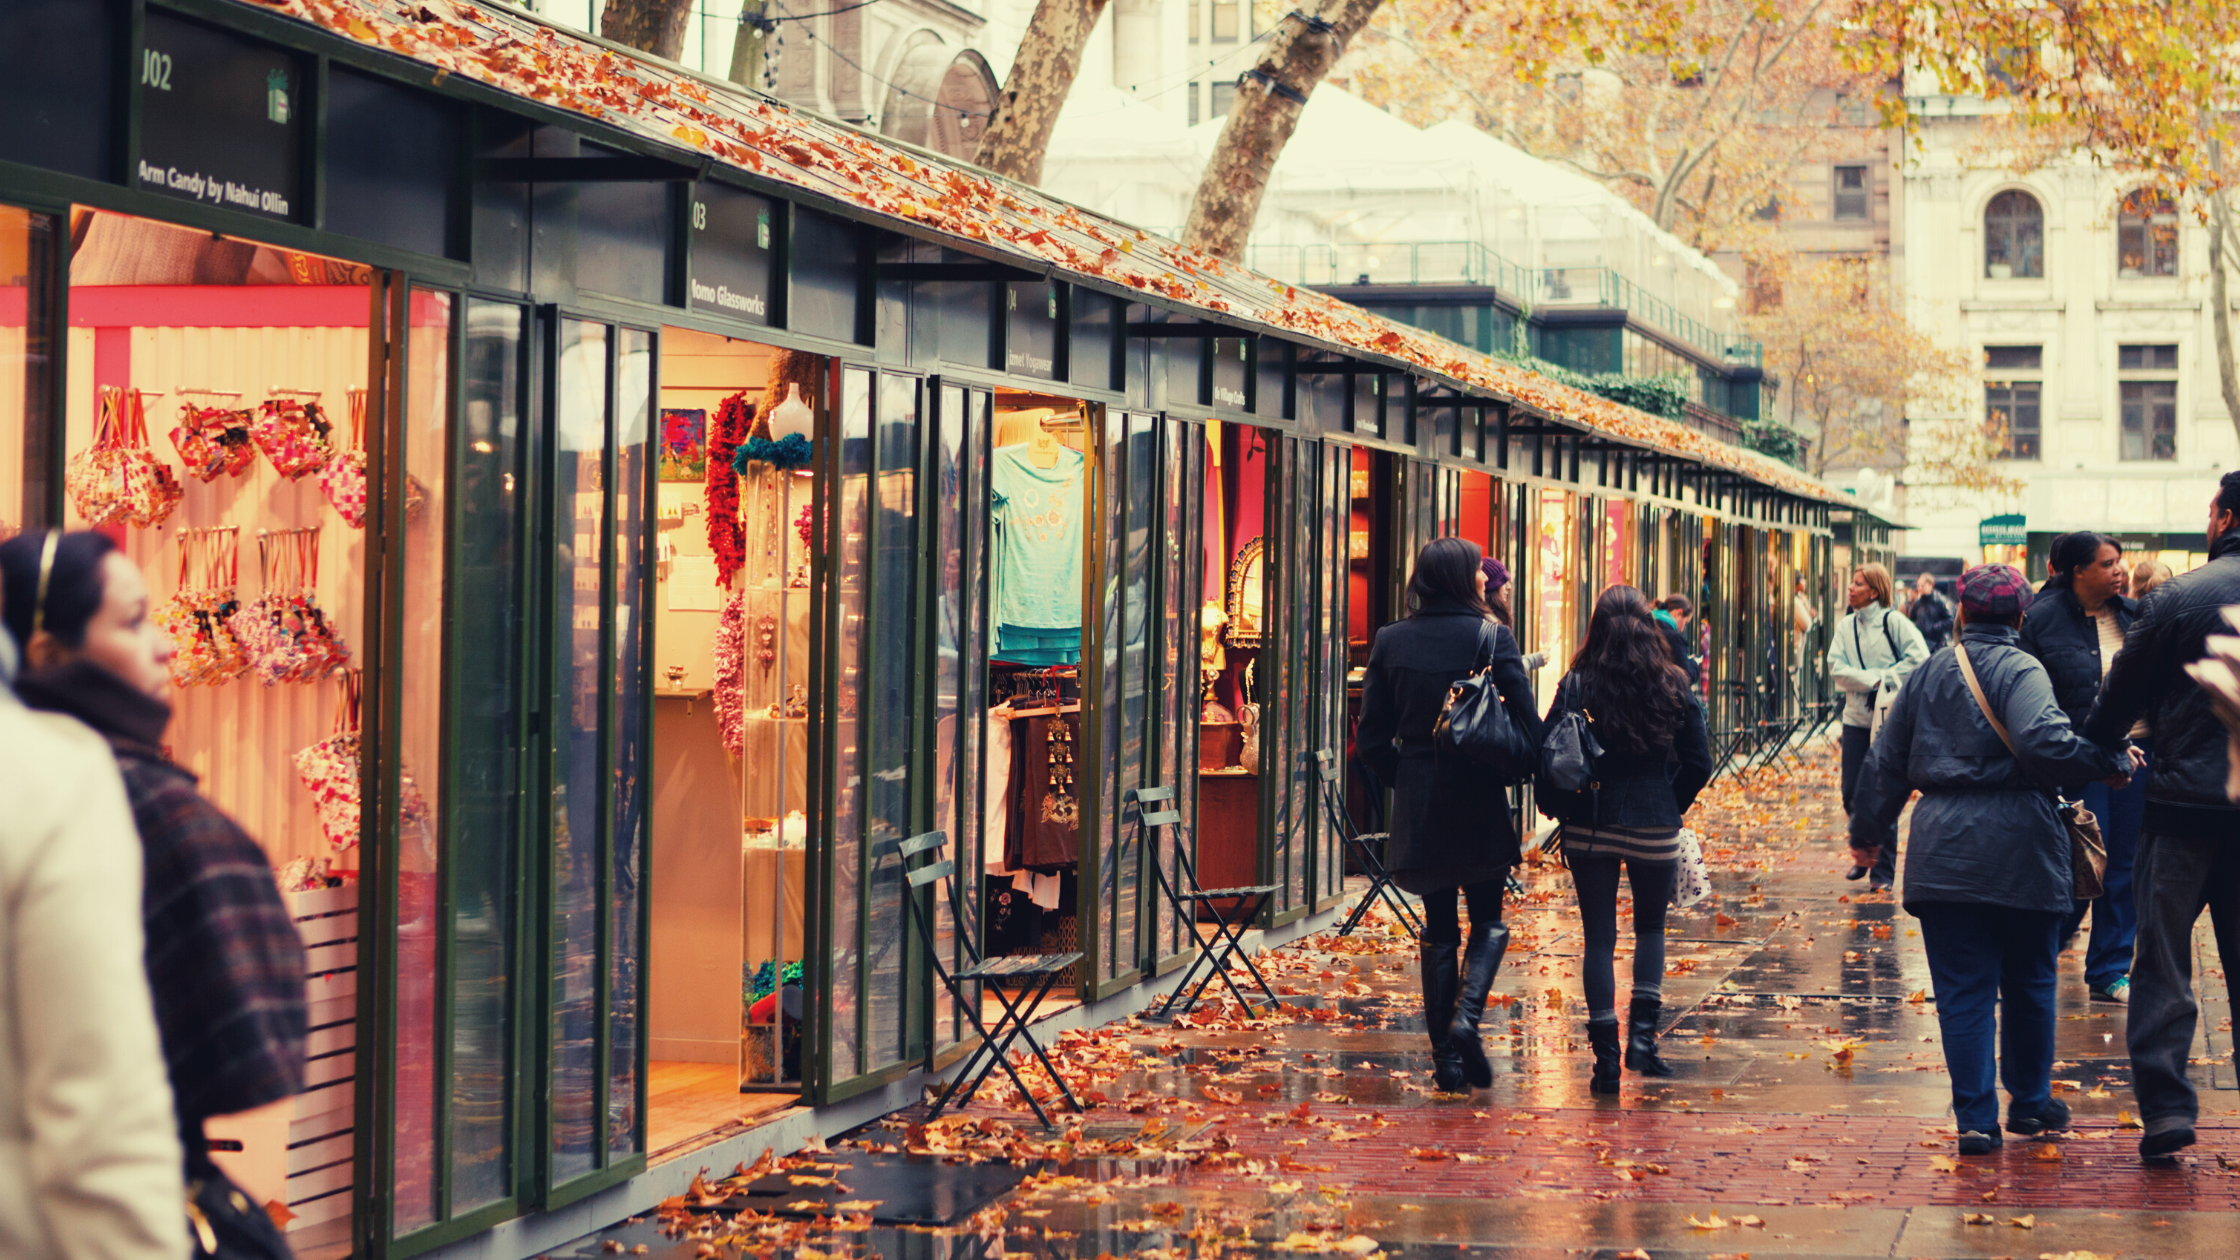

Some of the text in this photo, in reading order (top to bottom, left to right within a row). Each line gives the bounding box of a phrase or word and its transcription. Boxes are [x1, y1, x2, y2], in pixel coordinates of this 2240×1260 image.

[141, 49, 172, 91] J02
[138, 159, 289, 215] Arm Candy by Nahui Ollin
[717, 285, 765, 316] Glassworks
[1025, 353, 1053, 373] Yogawear
